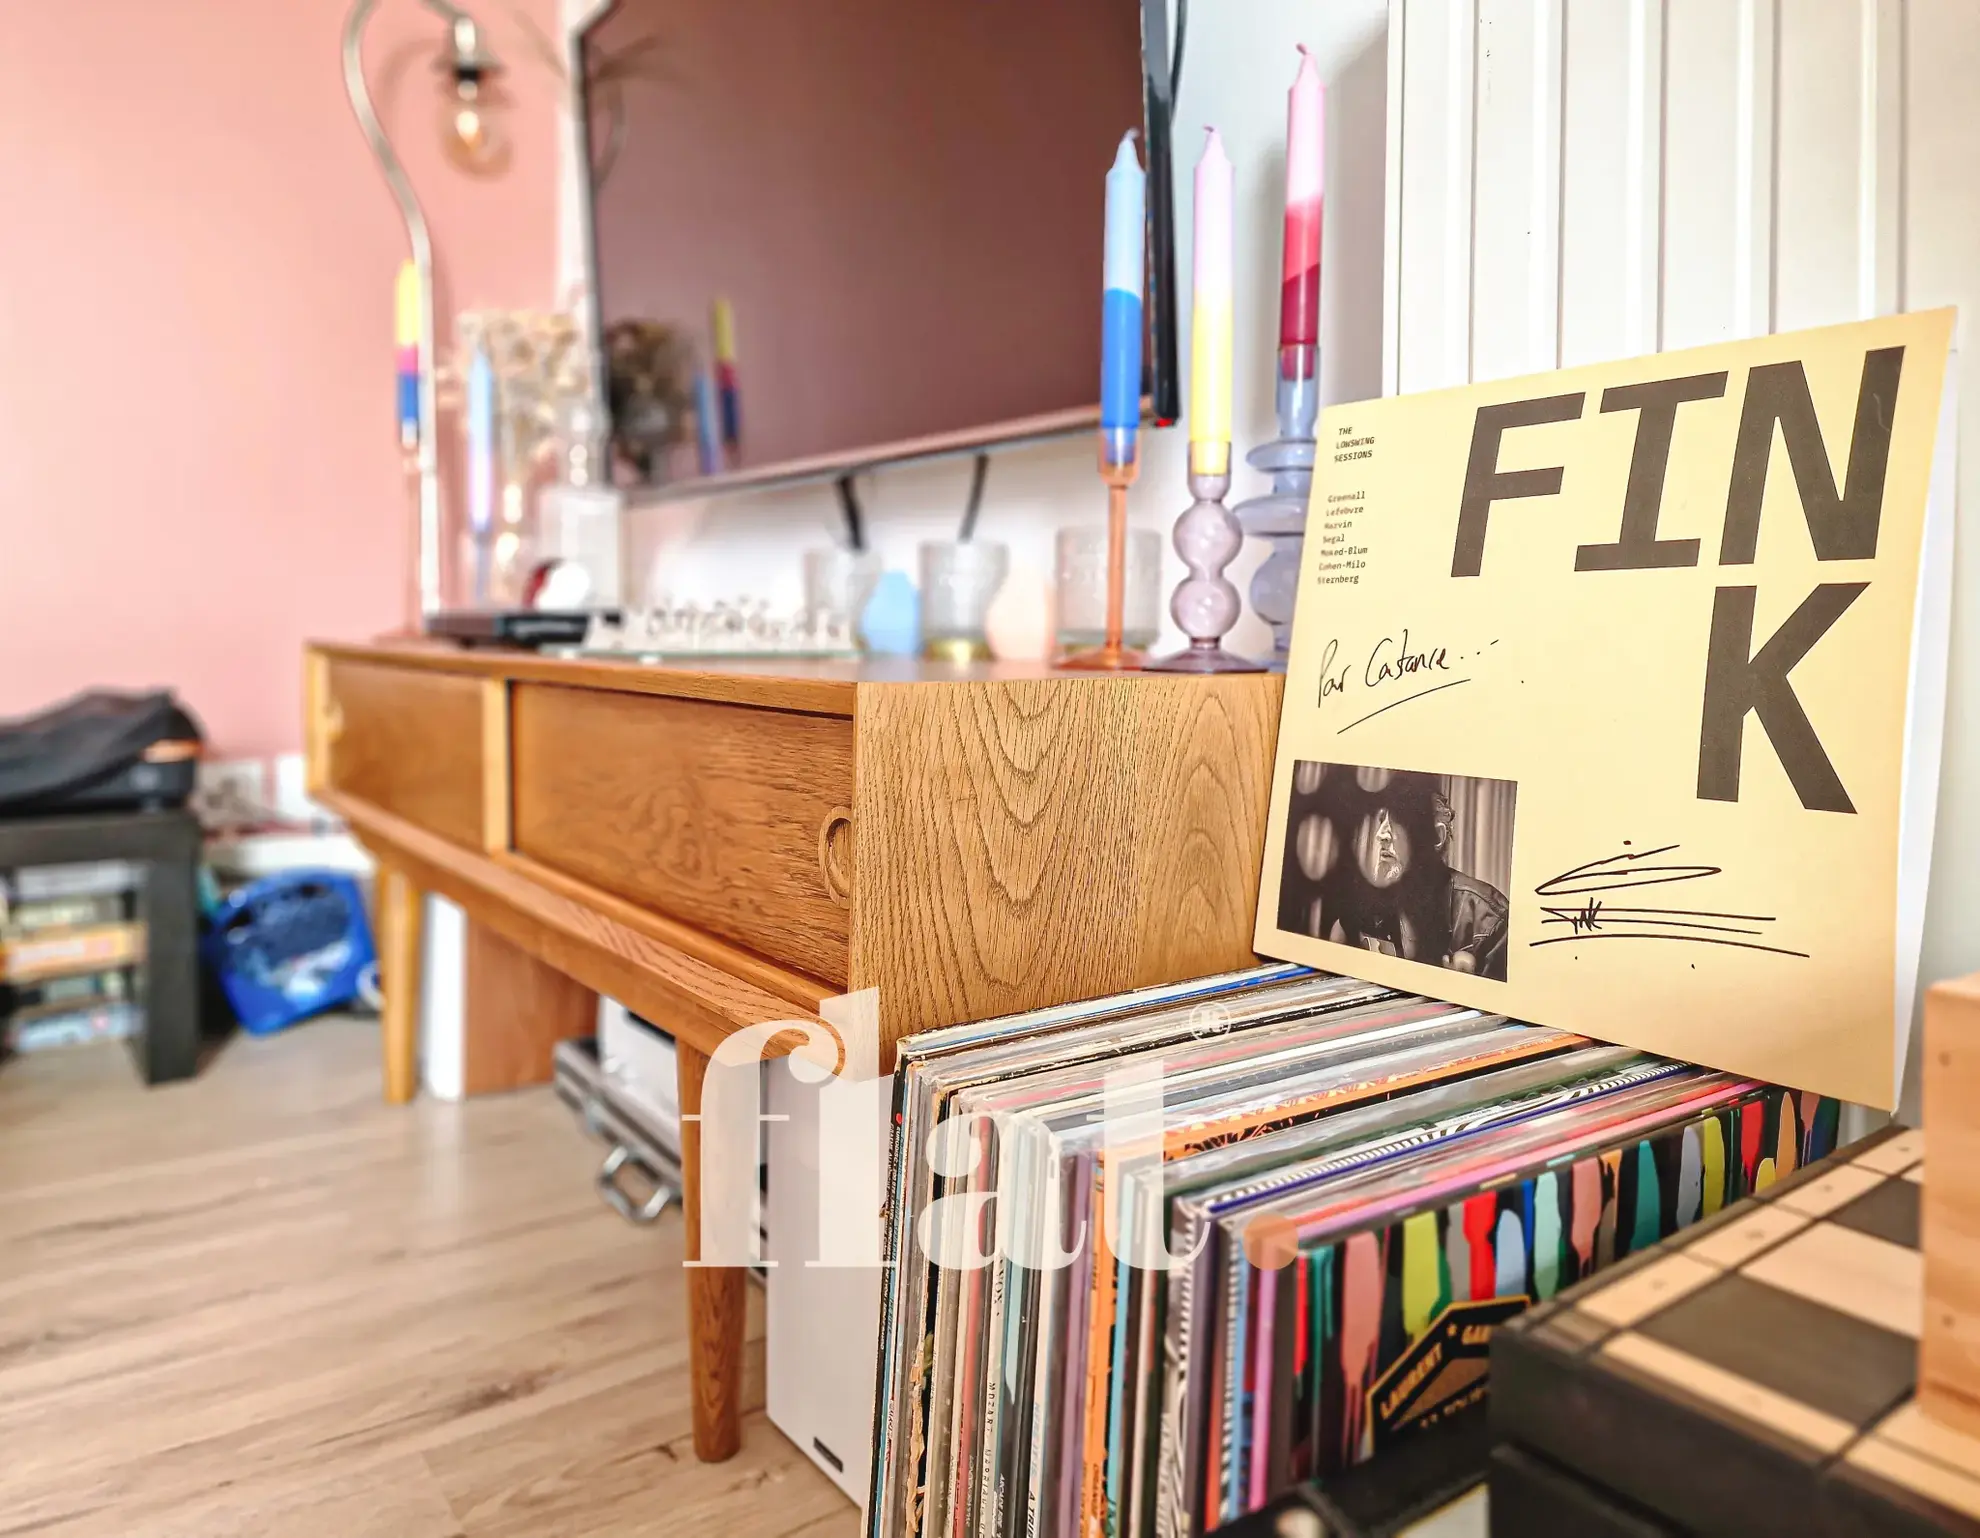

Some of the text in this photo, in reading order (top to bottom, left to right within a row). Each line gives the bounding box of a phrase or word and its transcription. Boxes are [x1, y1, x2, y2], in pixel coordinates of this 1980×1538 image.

[1338, 426, 1353, 436] THE
[1336, 436, 1375, 449] LOWSWING
[1334, 450, 1373, 463] SESSIONS
[1450, 345, 1906, 578] FIN
[1327, 491, 1366, 503] Greenall
[1322, 534, 1346, 545] Segal
[1316, 574, 1360, 585] Sternberg
[1696, 581, 1872, 815] K
[986, 1382, 996, 1433] MOZART
